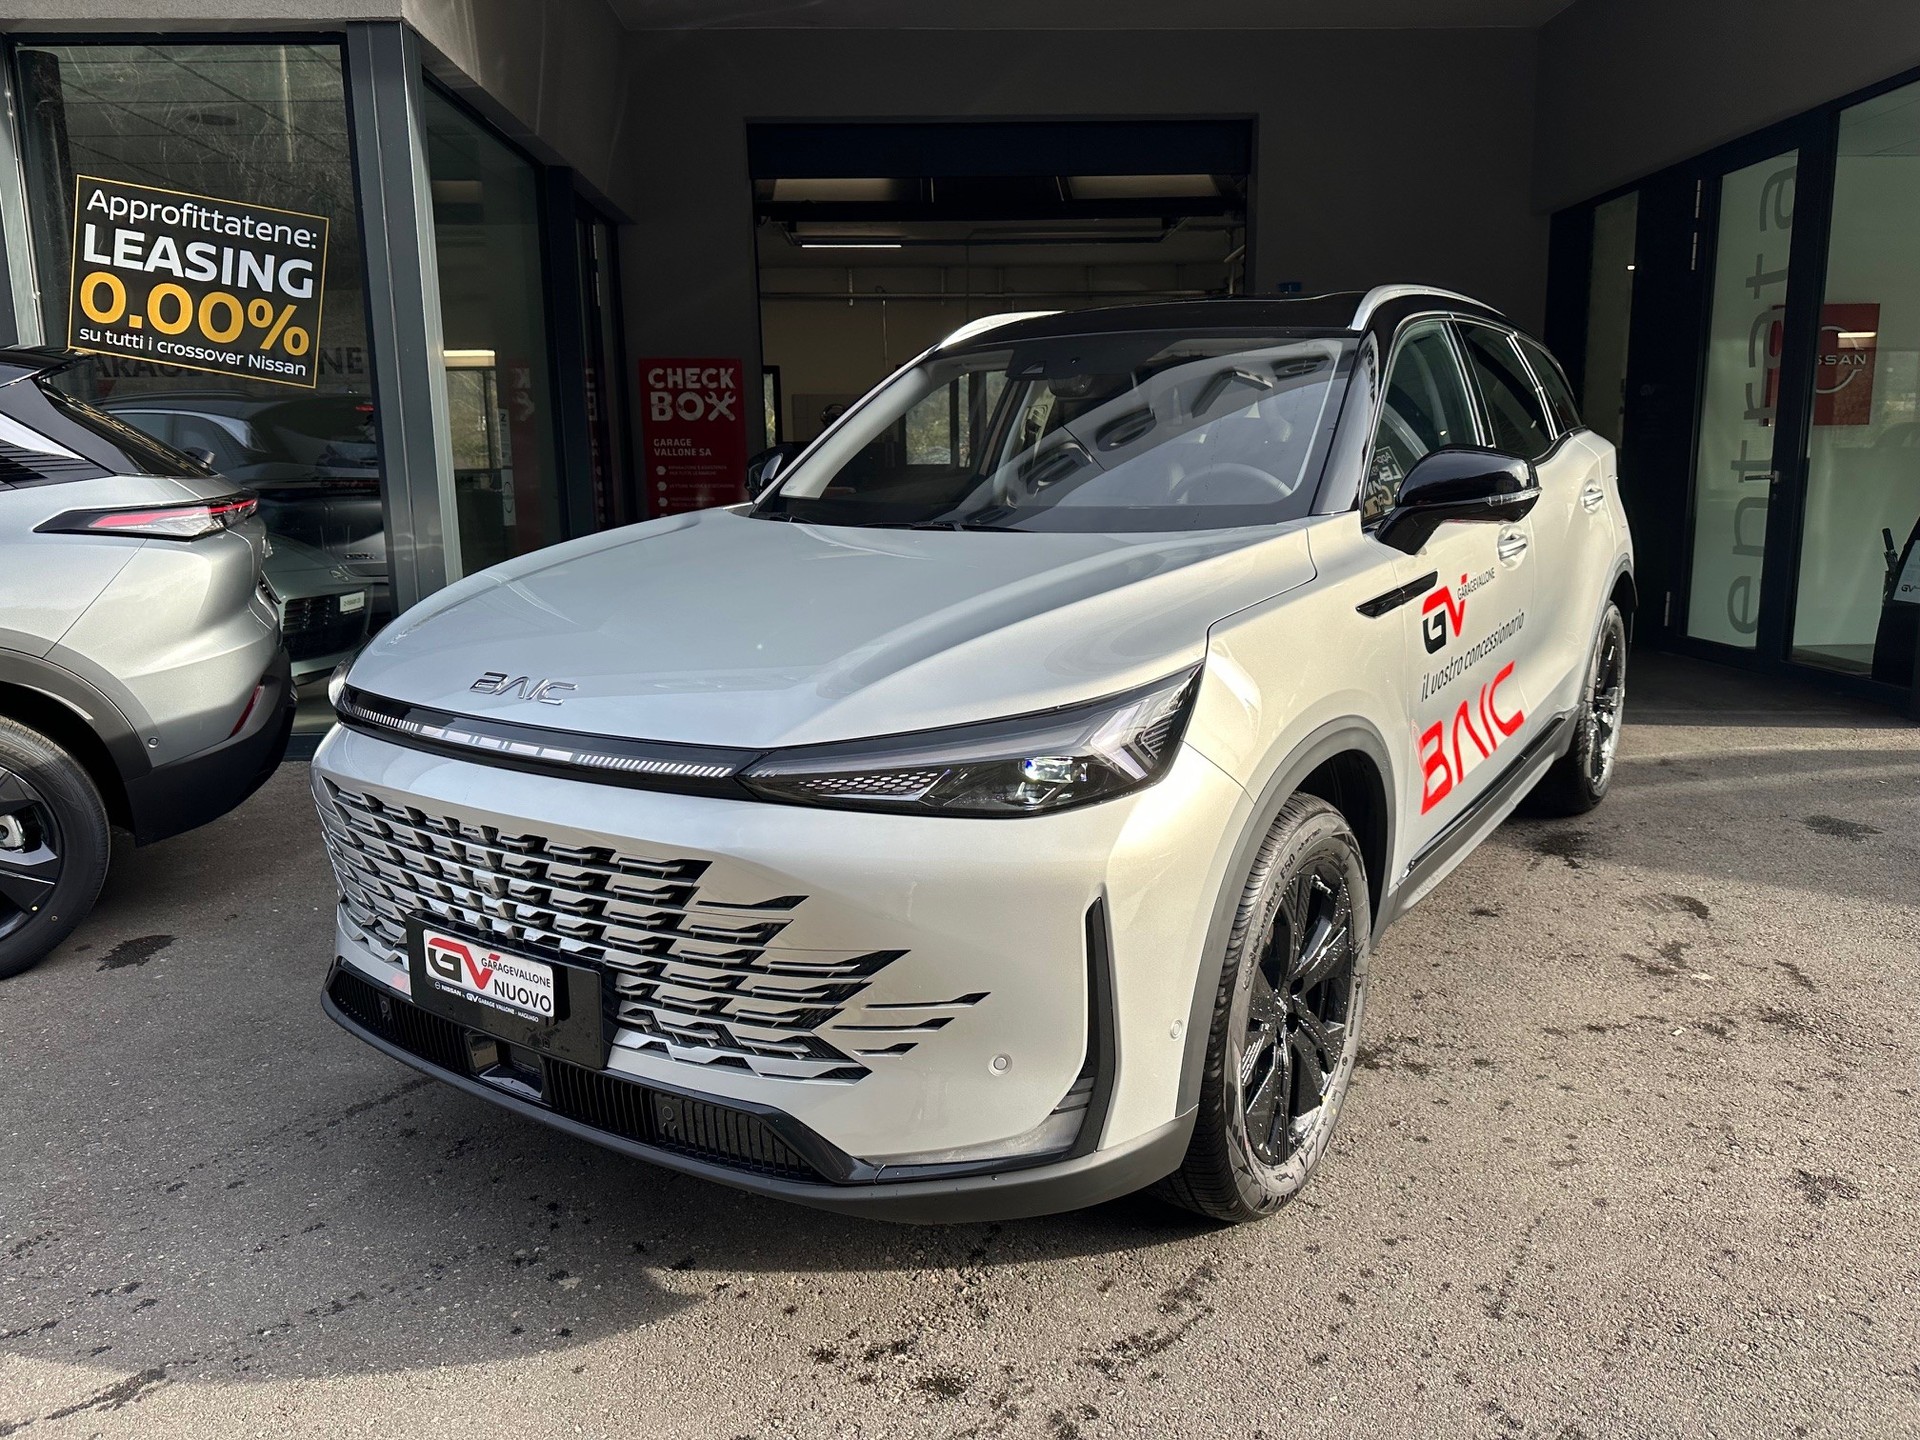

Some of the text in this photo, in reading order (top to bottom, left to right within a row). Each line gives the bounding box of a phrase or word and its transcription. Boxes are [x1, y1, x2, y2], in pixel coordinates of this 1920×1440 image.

[86, 189, 318, 250] Approfittatene:
[83, 223, 314, 299] LEASING
[80, 271, 310, 356] 0.00%
[79, 327, 101, 343] su
[104, 329, 144, 351] tutti
[148, 336, 153, 352] i
[157, 341, 244, 367] crossover
[248, 353, 306, 377] Nissan
[648, 367, 736, 390] CHECK
[1727, 165, 1797, 634] entrata
[650, 390, 736, 422] BOX
[653, 438, 692, 447] GARAGE
[653, 448, 712, 457] VALLONE SA
[1457, 567, 1496, 600] GARAGEVALLONE
[1421, 672, 1430, 702] il
[1464, 608, 1525, 671] concessionario
[1421, 660, 1525, 816] BAIC
[427, 937, 501, 990] GV
[481, 957, 551, 988] GARAGEVALLONE
[441, 984, 462, 997] NISSAN
[478, 997, 496, 1009] GARAGE
[495, 1003, 515, 1015] VALLONE
[493, 979, 552, 1013] NUOVO
